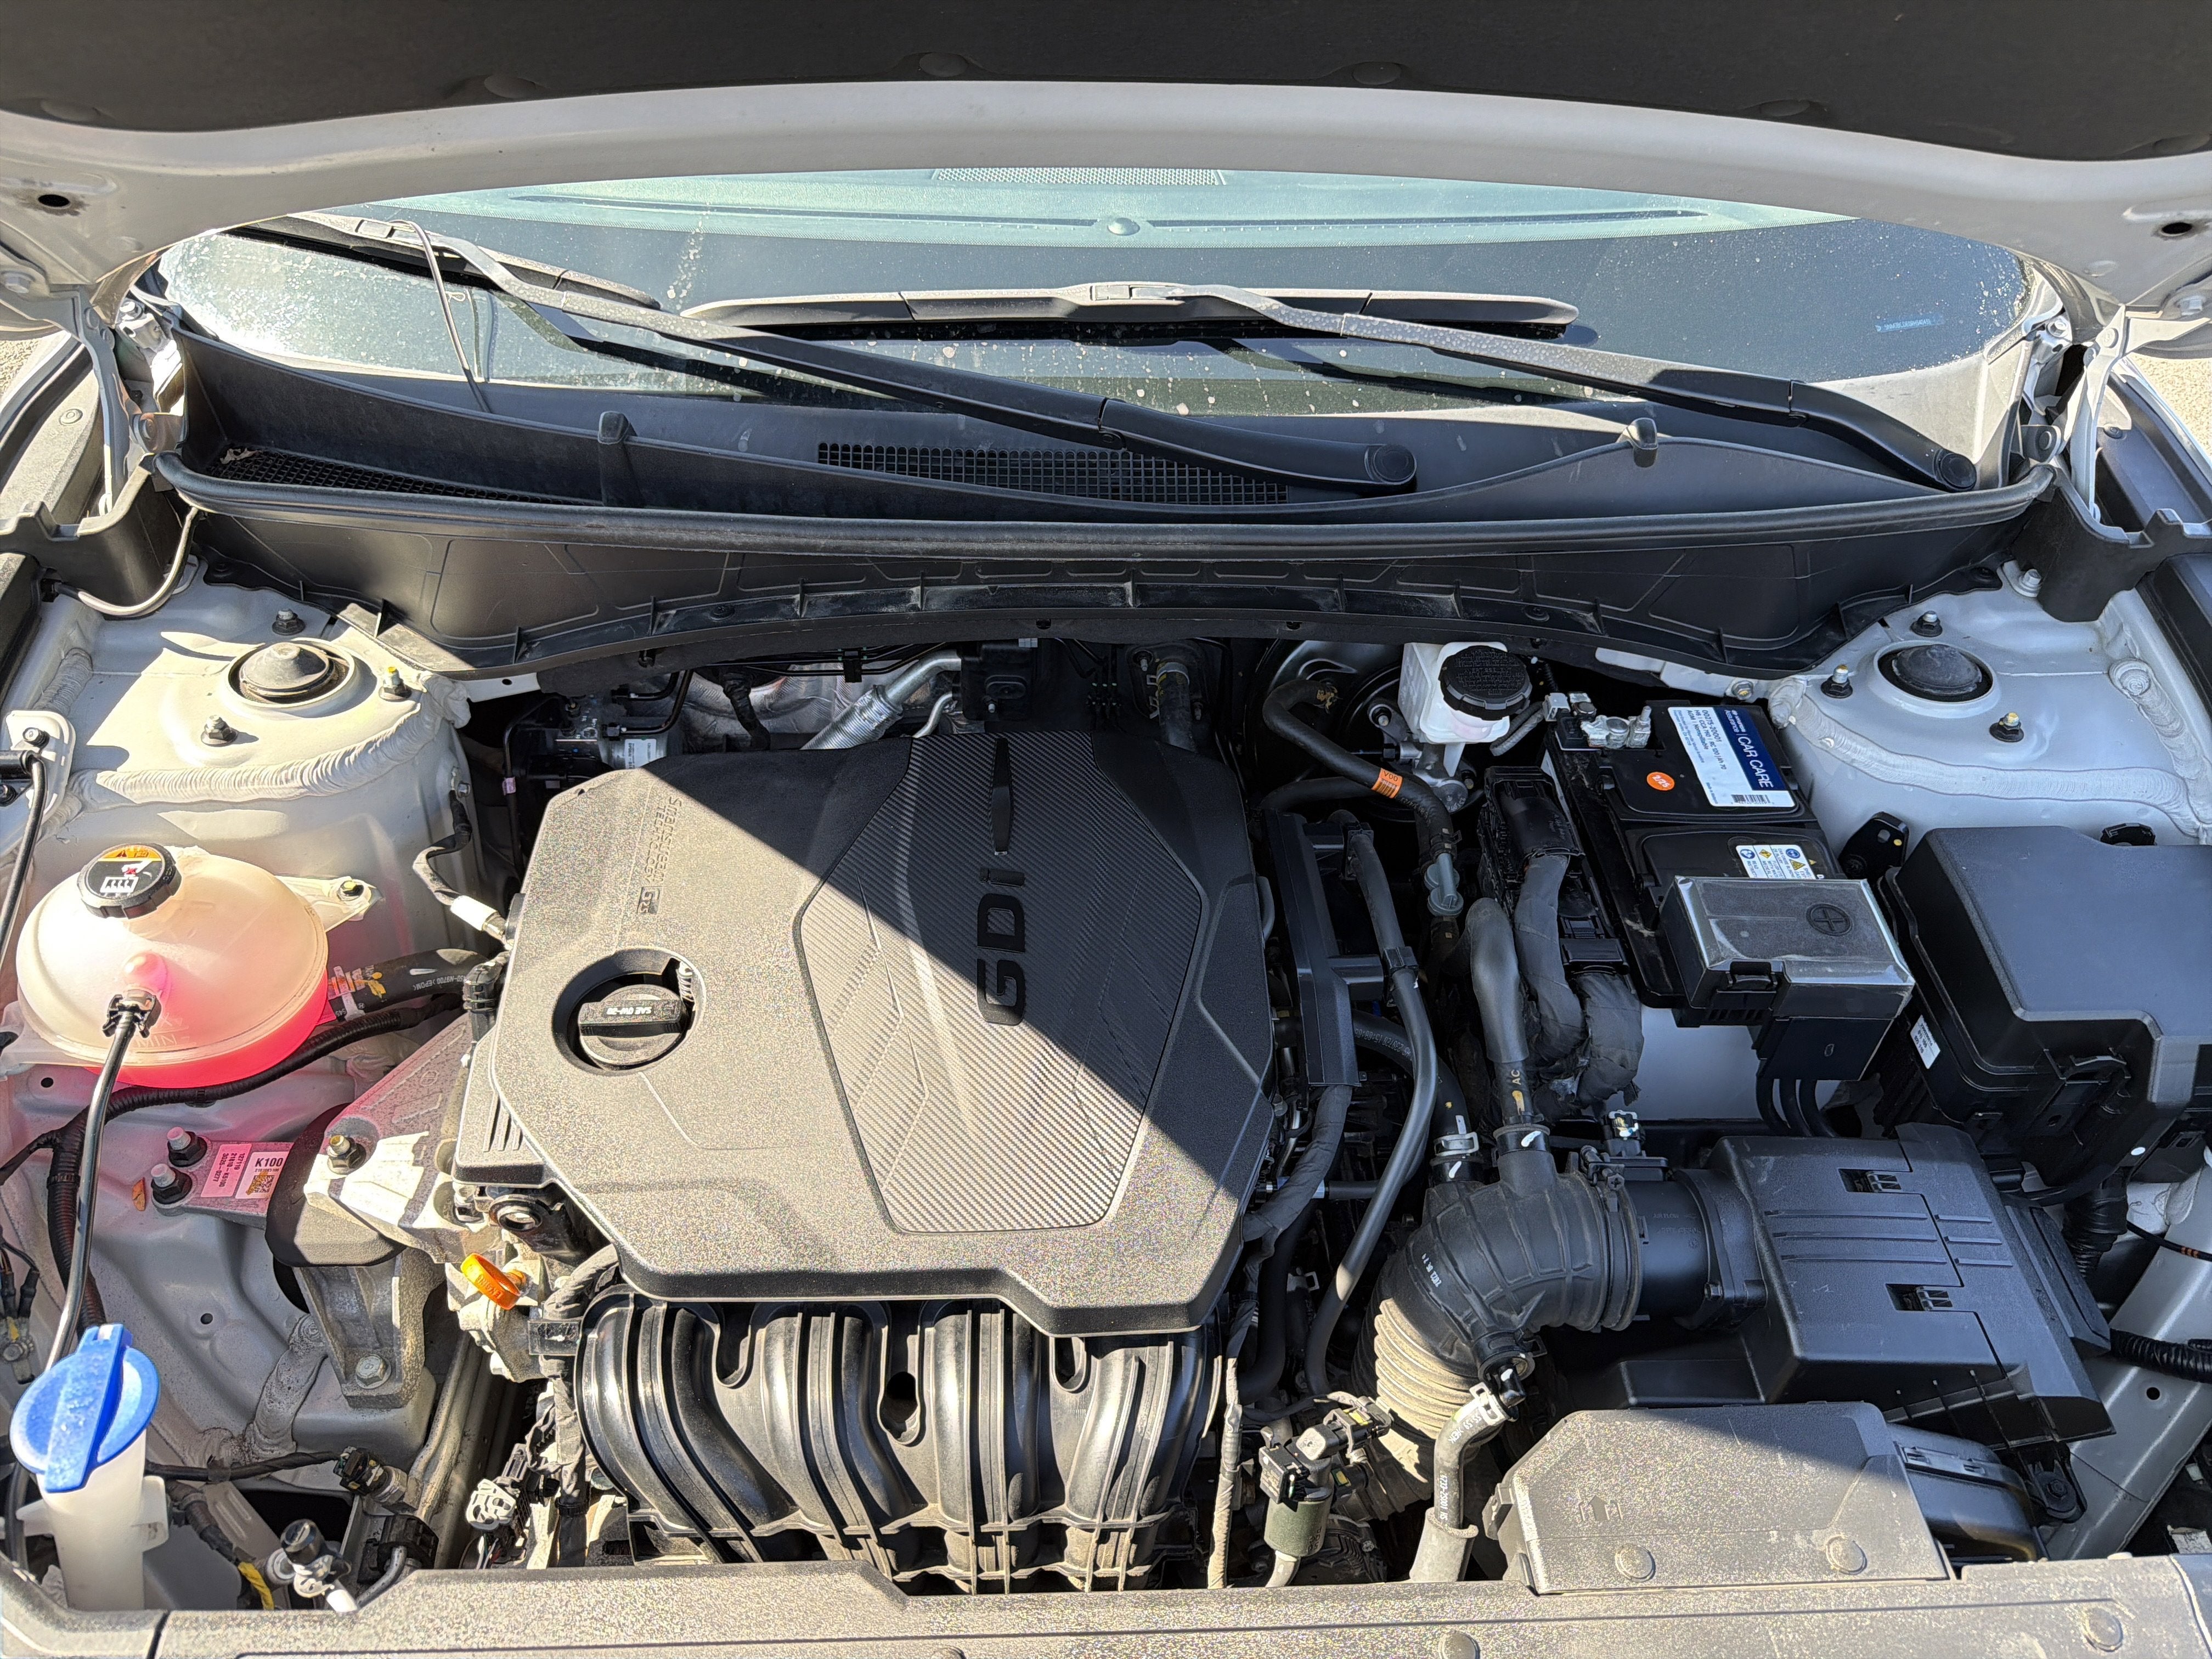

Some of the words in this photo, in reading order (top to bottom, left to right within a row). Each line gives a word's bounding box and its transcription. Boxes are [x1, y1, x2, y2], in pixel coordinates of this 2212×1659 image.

[1686, 710, 1696, 720] AGM
[1724, 709, 1739, 732] Assurance
[1699, 720, 1707, 729] CCA
[1738, 736, 1758, 757] CAR
[1750, 760, 1774, 788] CARE
[1652, 775, 1671, 788] 2/25
[653, 797, 682, 882] Smartstream
[635, 1006, 652, 1014] SAE
[1511, 1069, 1521, 1085] AC
[234, 1153, 246, 1170] 127119
[255, 1158, 284, 1167] K100
